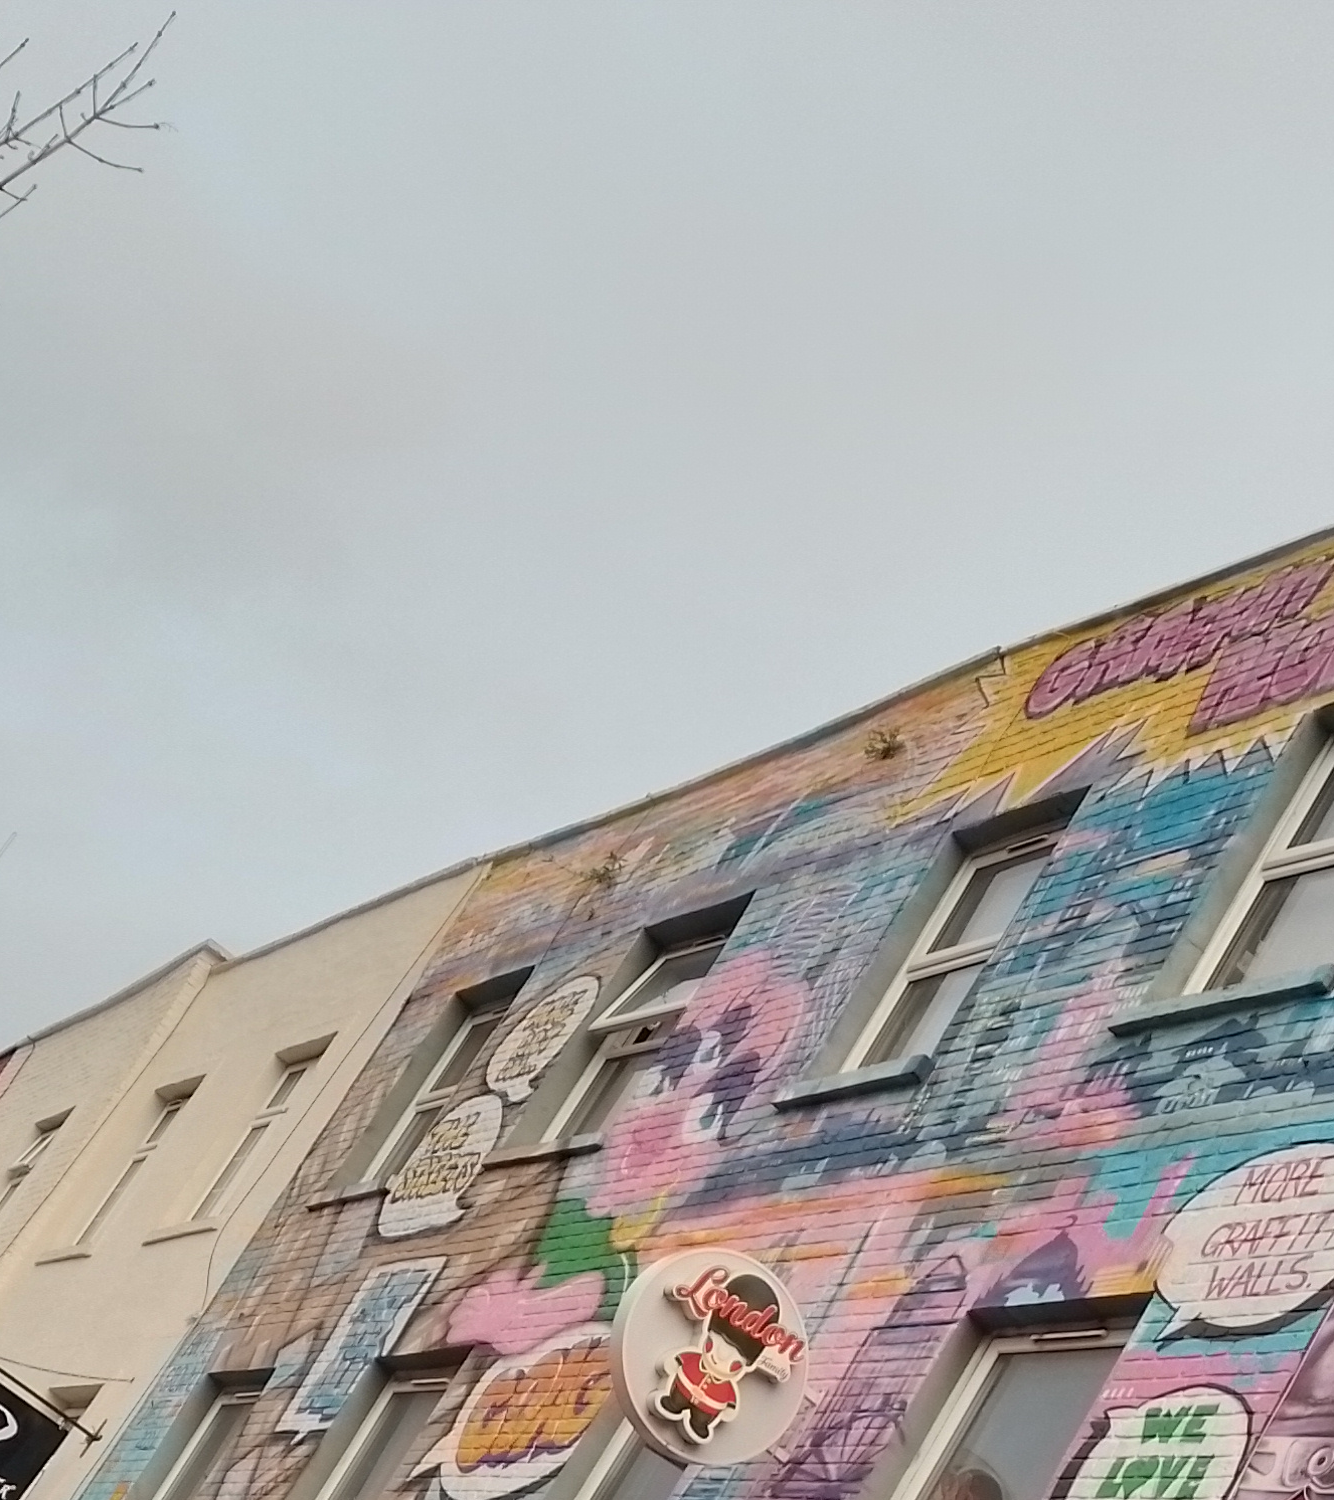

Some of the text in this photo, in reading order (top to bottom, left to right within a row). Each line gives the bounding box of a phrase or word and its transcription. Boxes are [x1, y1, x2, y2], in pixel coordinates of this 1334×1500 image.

[1231, 1156, 1328, 1208] MORE
[672, 1264, 806, 1364] London
[1141, 1403, 1212, 1446] WE
